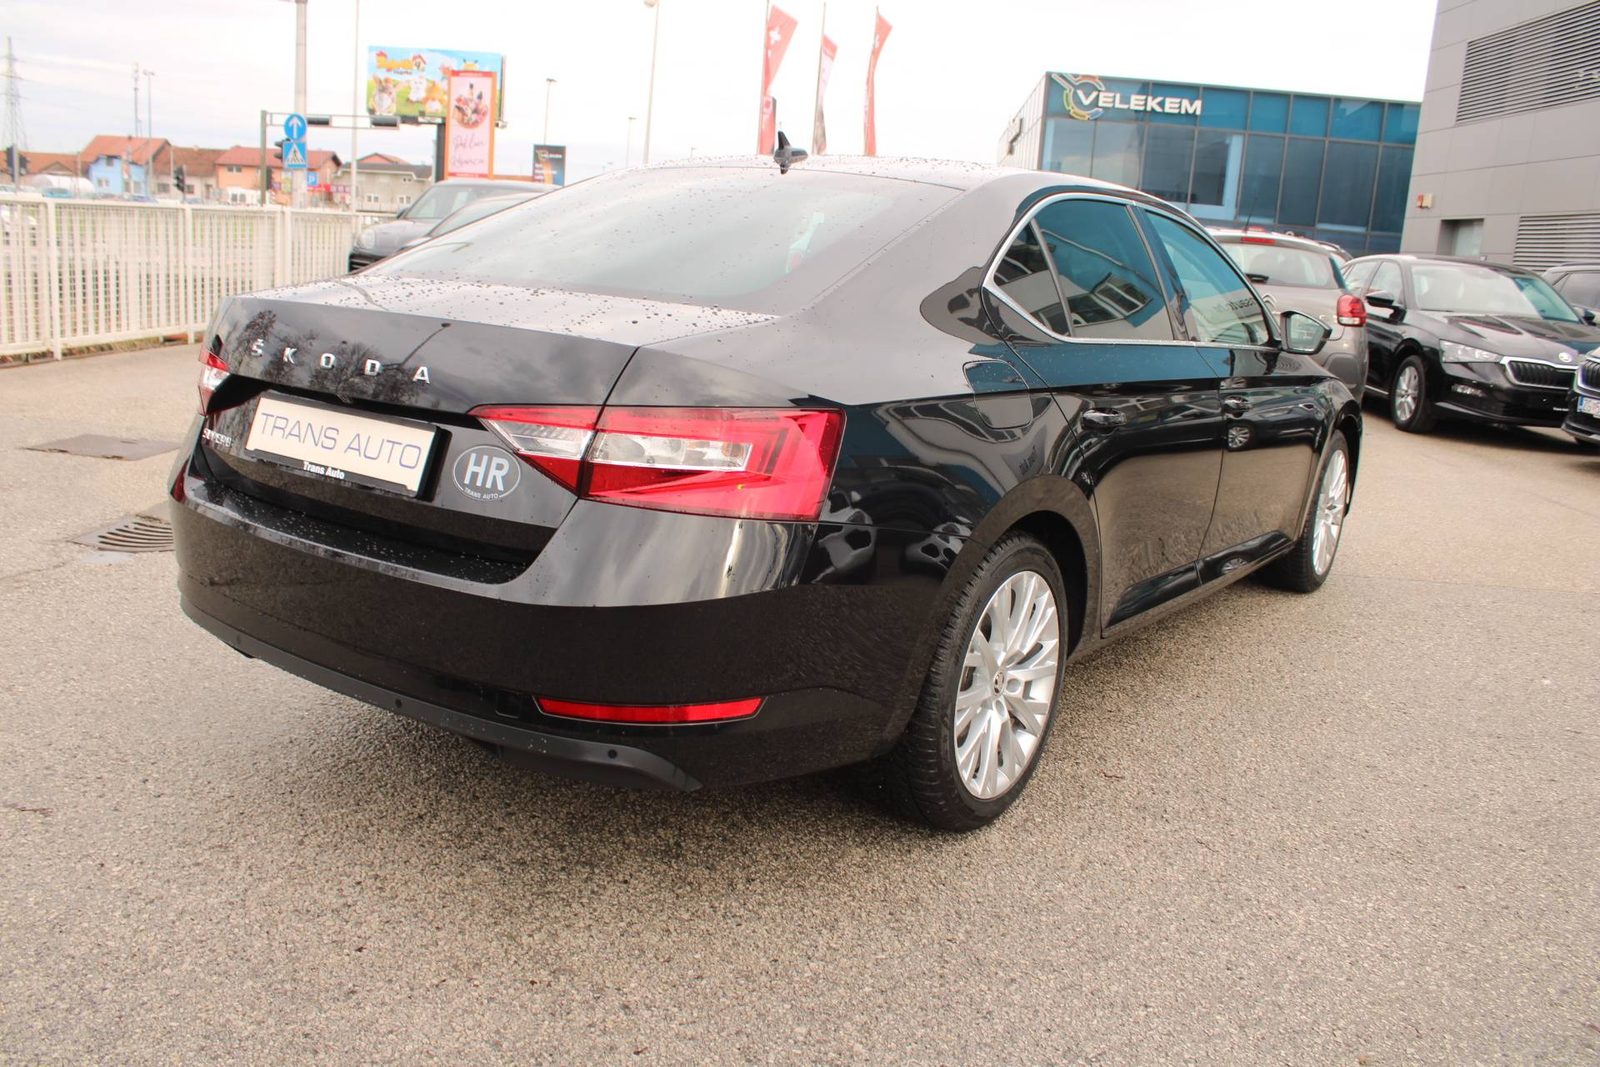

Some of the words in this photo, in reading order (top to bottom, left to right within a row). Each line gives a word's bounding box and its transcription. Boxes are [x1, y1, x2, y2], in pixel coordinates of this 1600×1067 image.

[1076, 89, 1202, 116] VELEKEM
[250, 338, 431, 384] ŠKODA
[261, 412, 340, 451] TRANS
[344, 432, 422, 470] AUTO
[303, 460, 325, 475] Trans
[326, 466, 345, 480] Auto
[463, 452, 510, 492] HR
[464, 487, 482, 499] TRANS
[482, 492, 499, 500] AUTO
